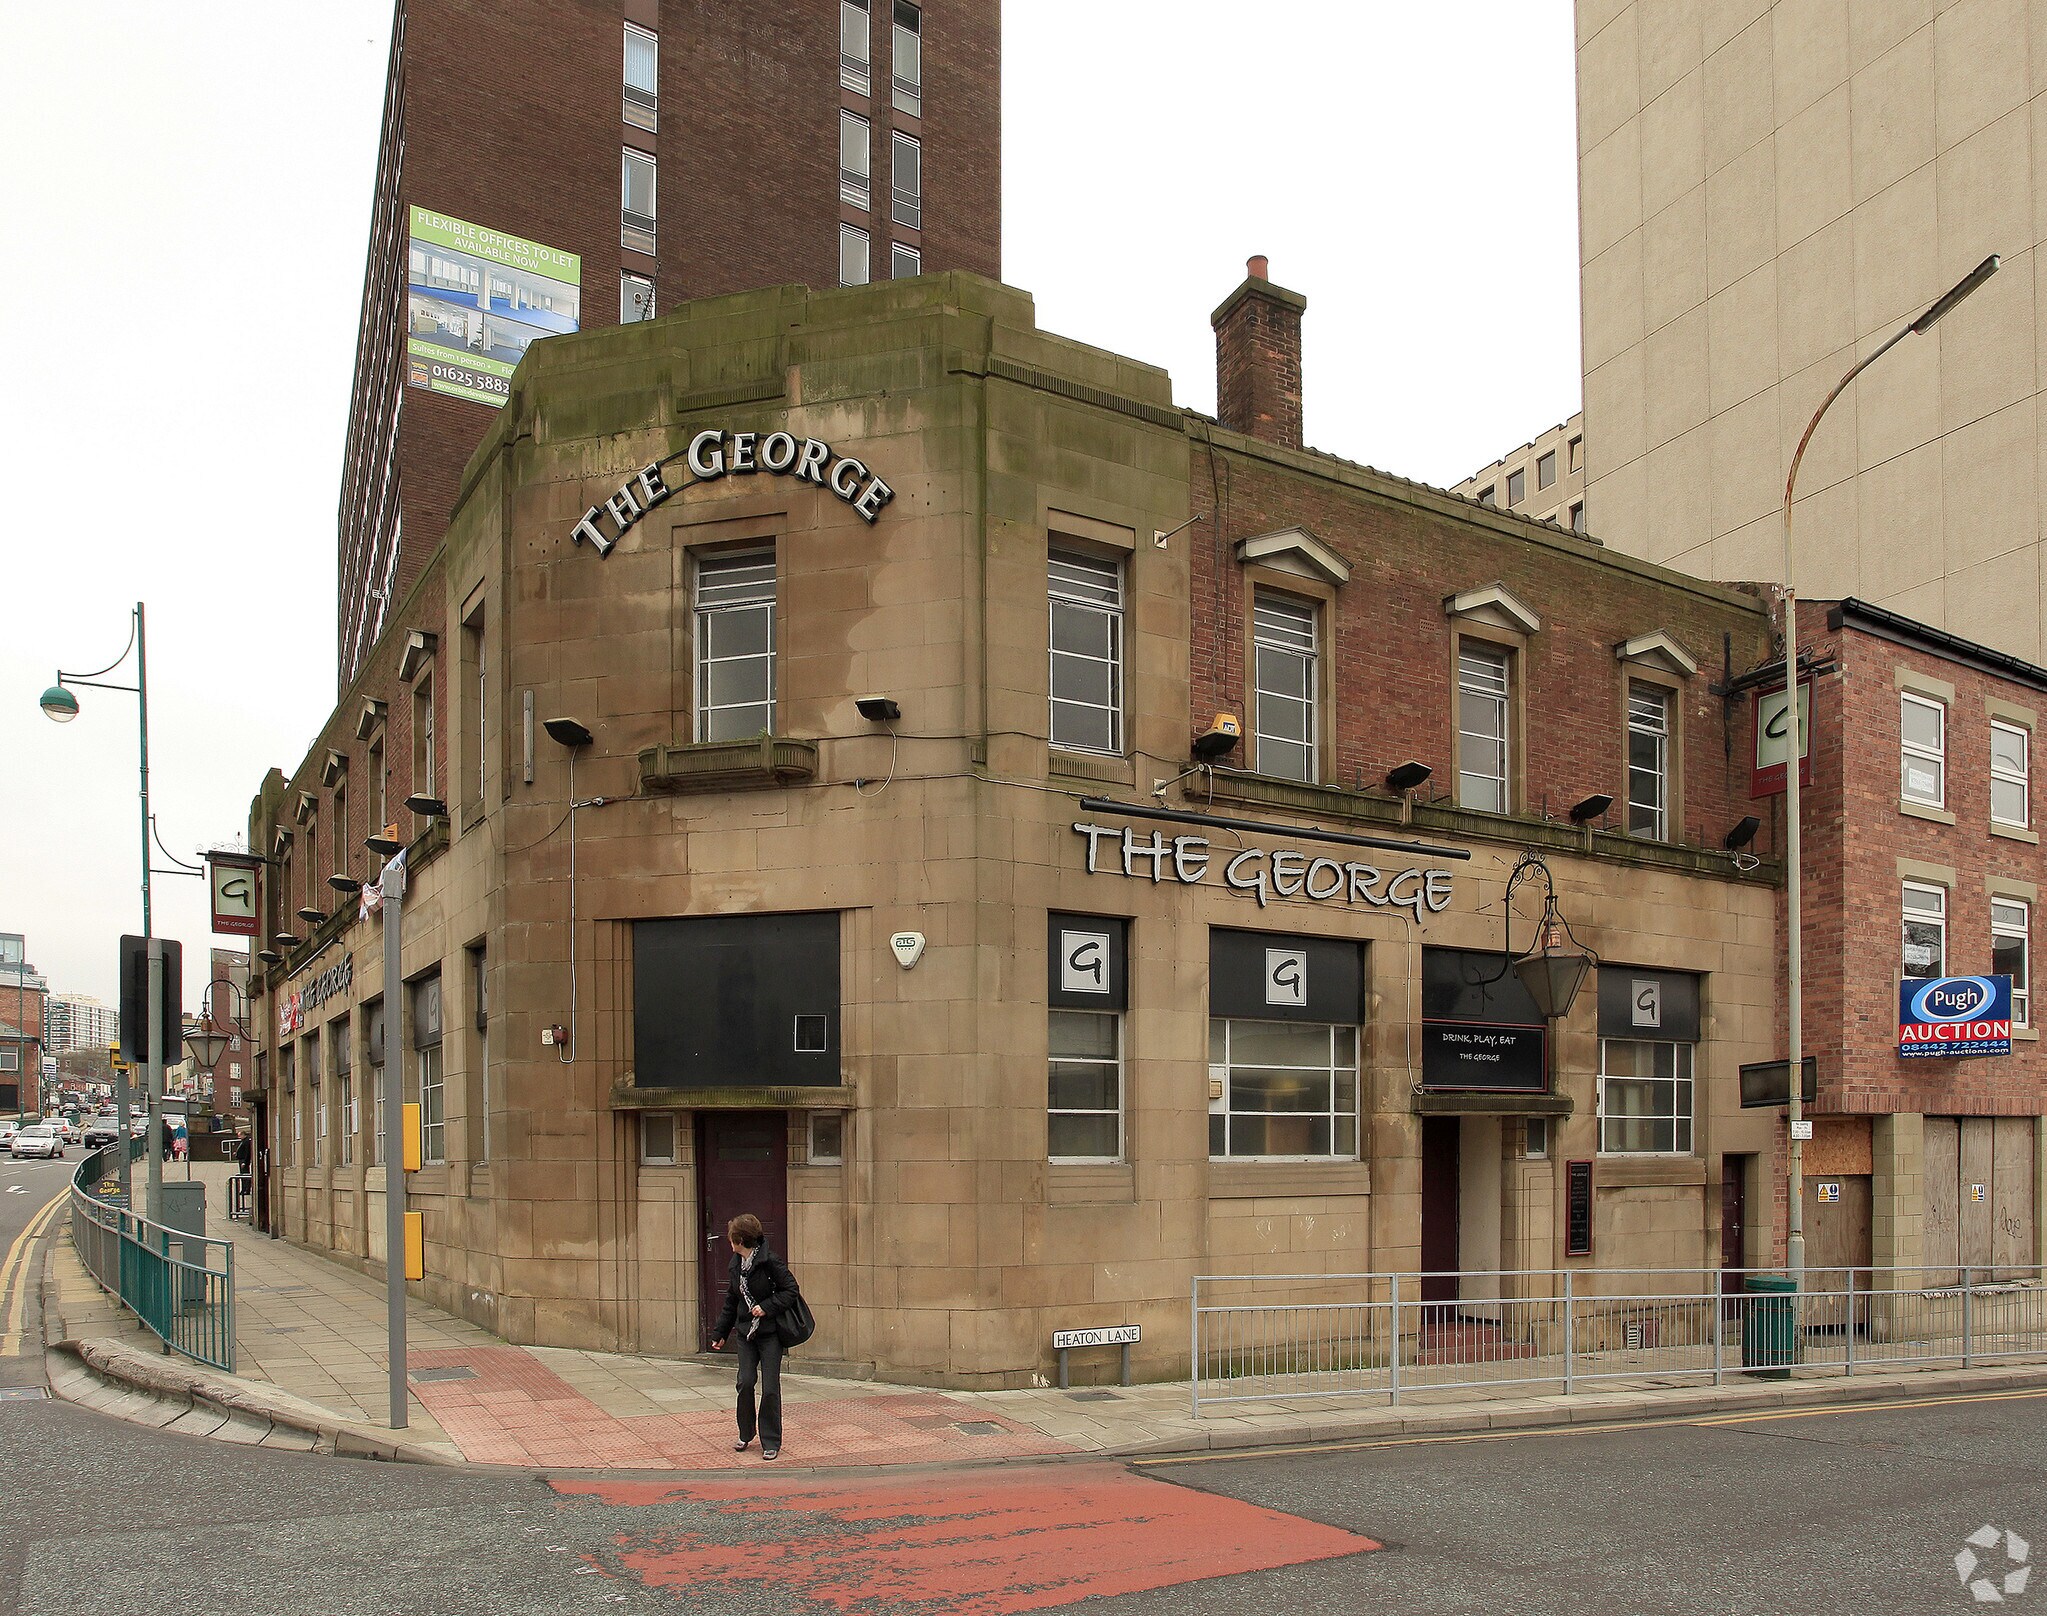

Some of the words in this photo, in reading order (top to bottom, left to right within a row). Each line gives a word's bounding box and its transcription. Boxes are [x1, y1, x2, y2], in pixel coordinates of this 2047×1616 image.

[418, 212, 476, 240] FLEXIBLE
[479, 230, 530, 255] OFFICES
[532, 246, 549, 261] TO
[552, 254, 574, 268] LET
[454, 236, 511, 262] AVAILABLE
[512, 255, 539, 269] NOW
[412, 343, 435, 355] Suites
[436, 349, 456, 361] from
[460, 356, 486, 370] person
[432, 365, 474, 387] 01625
[476, 375, 510, 394] 5882
[570, 461, 670, 558] THE
[687, 430, 896, 525] GEORGE
[1071, 822, 1210, 884] THE
[1225, 848, 1454, 925] GEORGE
[1069, 941, 1102, 985] G
[1272, 958, 1301, 998] G
[1636, 988, 1656, 1021] G
[1934, 987, 1978, 1010] Pugh
[1442, 1033, 1472, 1044] DRINK,
[1473, 1034, 1498, 1047] PLAY,
[1499, 1036, 1517, 1045] EAT
[1901, 1021, 2010, 1041] AUCTION
[1473, 1053, 1500, 1062] GEORGE
[1901, 1043, 1947, 1051] 08442
[1952, 1040, 2009, 1049] 722444
[1901, 1047, 2009, 1057] www.pugh-auctions.com
[1057, 1331, 1102, 1346] HEATON
[1107, 1328, 1137, 1342] LANE
